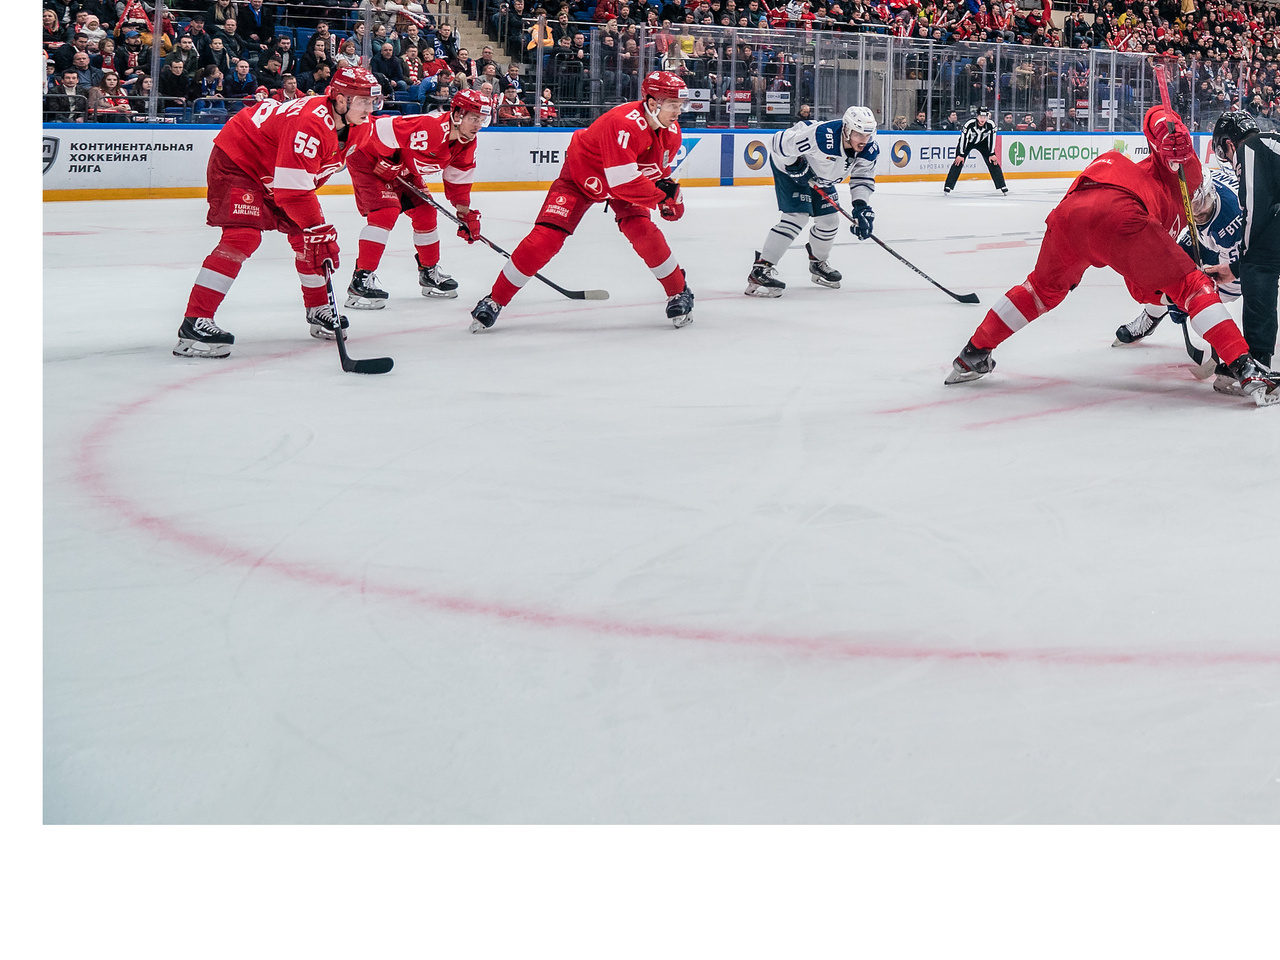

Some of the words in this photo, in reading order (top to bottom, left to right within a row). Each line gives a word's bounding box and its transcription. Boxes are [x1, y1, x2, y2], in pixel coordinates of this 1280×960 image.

[727, 92, 751, 100] FNBET
[294, 131, 320, 159] 55
[409, 130, 428, 151] 93
[617, 130, 631, 150] 11
[796, 137, 812, 153] 10
[825, 134, 834, 150] ВТБ
[70, 142, 194, 152] КОНТИНЕНТАЛЬНАЯ
[69, 152, 148, 162] ХОККЕЙНАЯ
[530, 151, 560, 164] THE
[920, 147, 977, 160] ERIEL
[68, 164, 102, 173] ЛИГА
[234, 203, 260, 211] TURKISH
[548, 204, 570, 214] TURKISH
[232, 209, 260, 217] AIRLINES
[546, 208, 568, 218] AIRLINES
